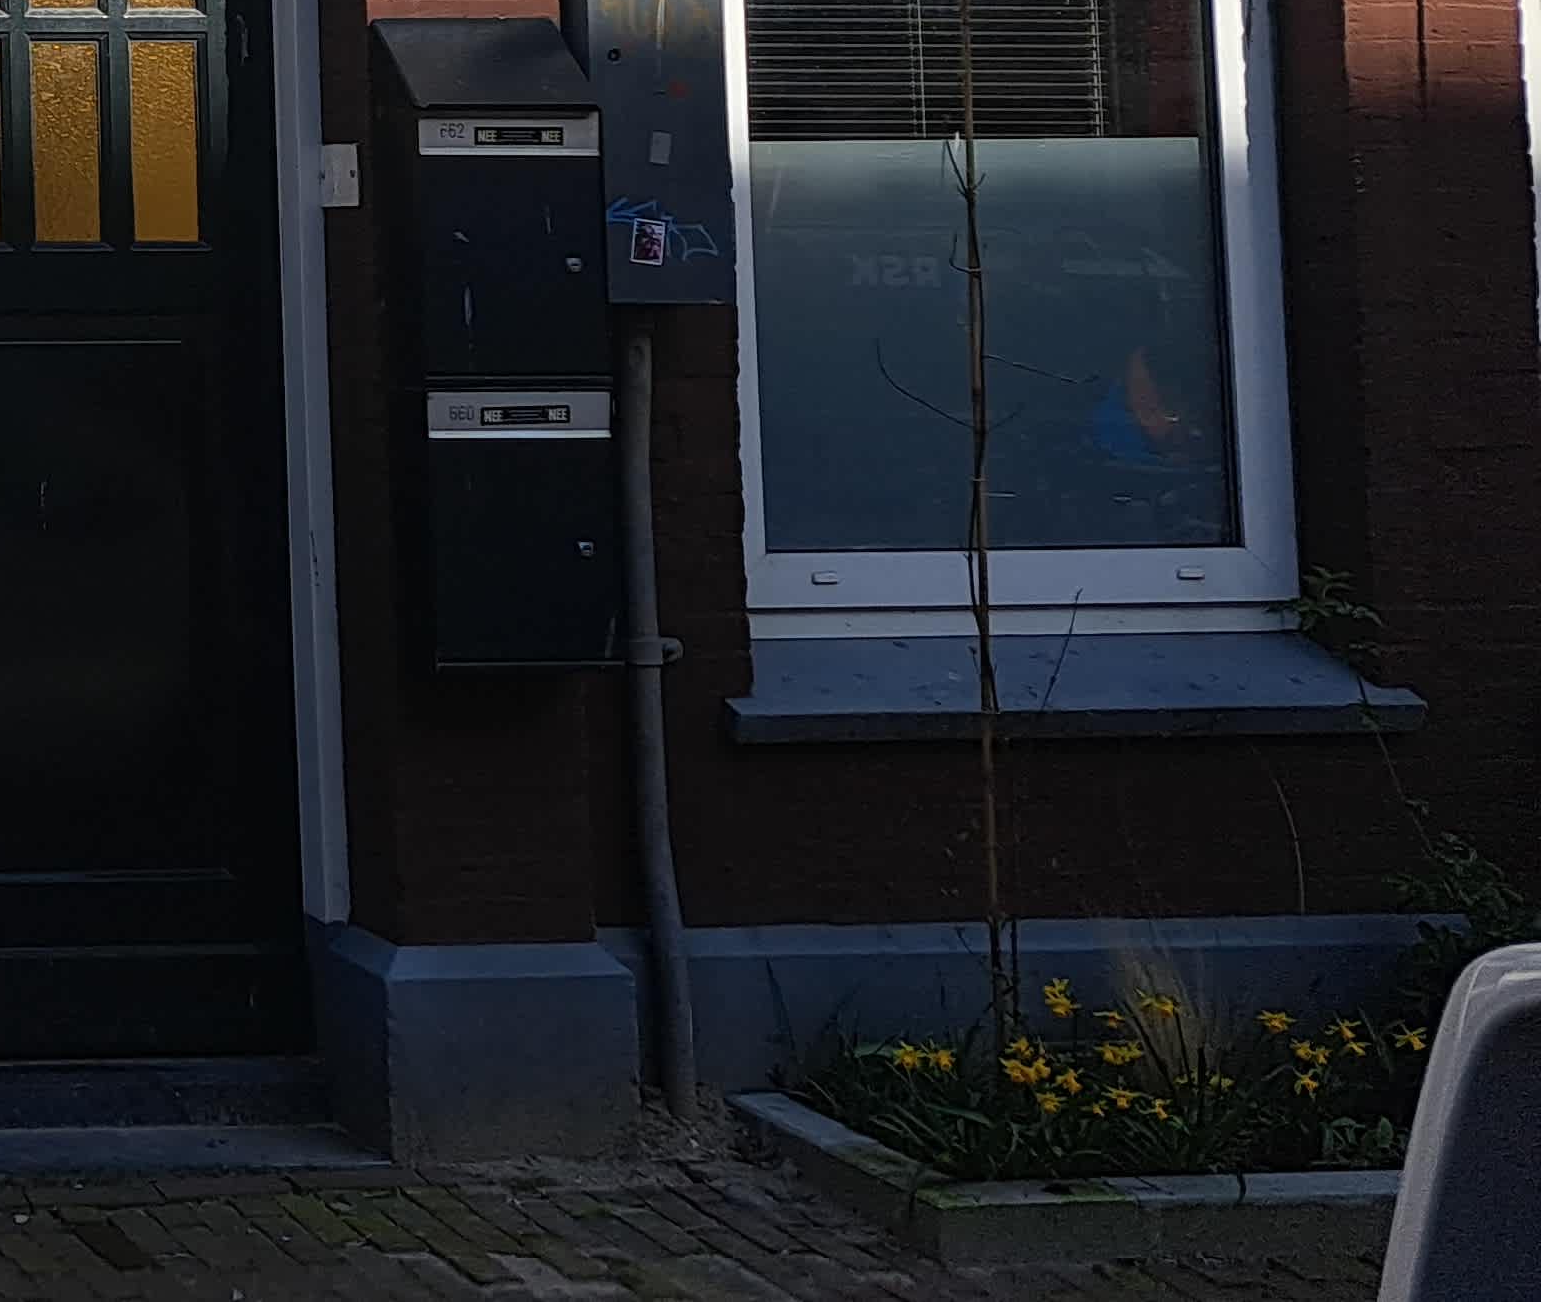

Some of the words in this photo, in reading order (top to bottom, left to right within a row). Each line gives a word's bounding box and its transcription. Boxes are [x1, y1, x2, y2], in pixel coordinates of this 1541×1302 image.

[477, 130, 497, 142] NEE
[541, 130, 561, 142] NEE
[484, 410, 502, 422] NEE
[549, 408, 567, 421] NEE
